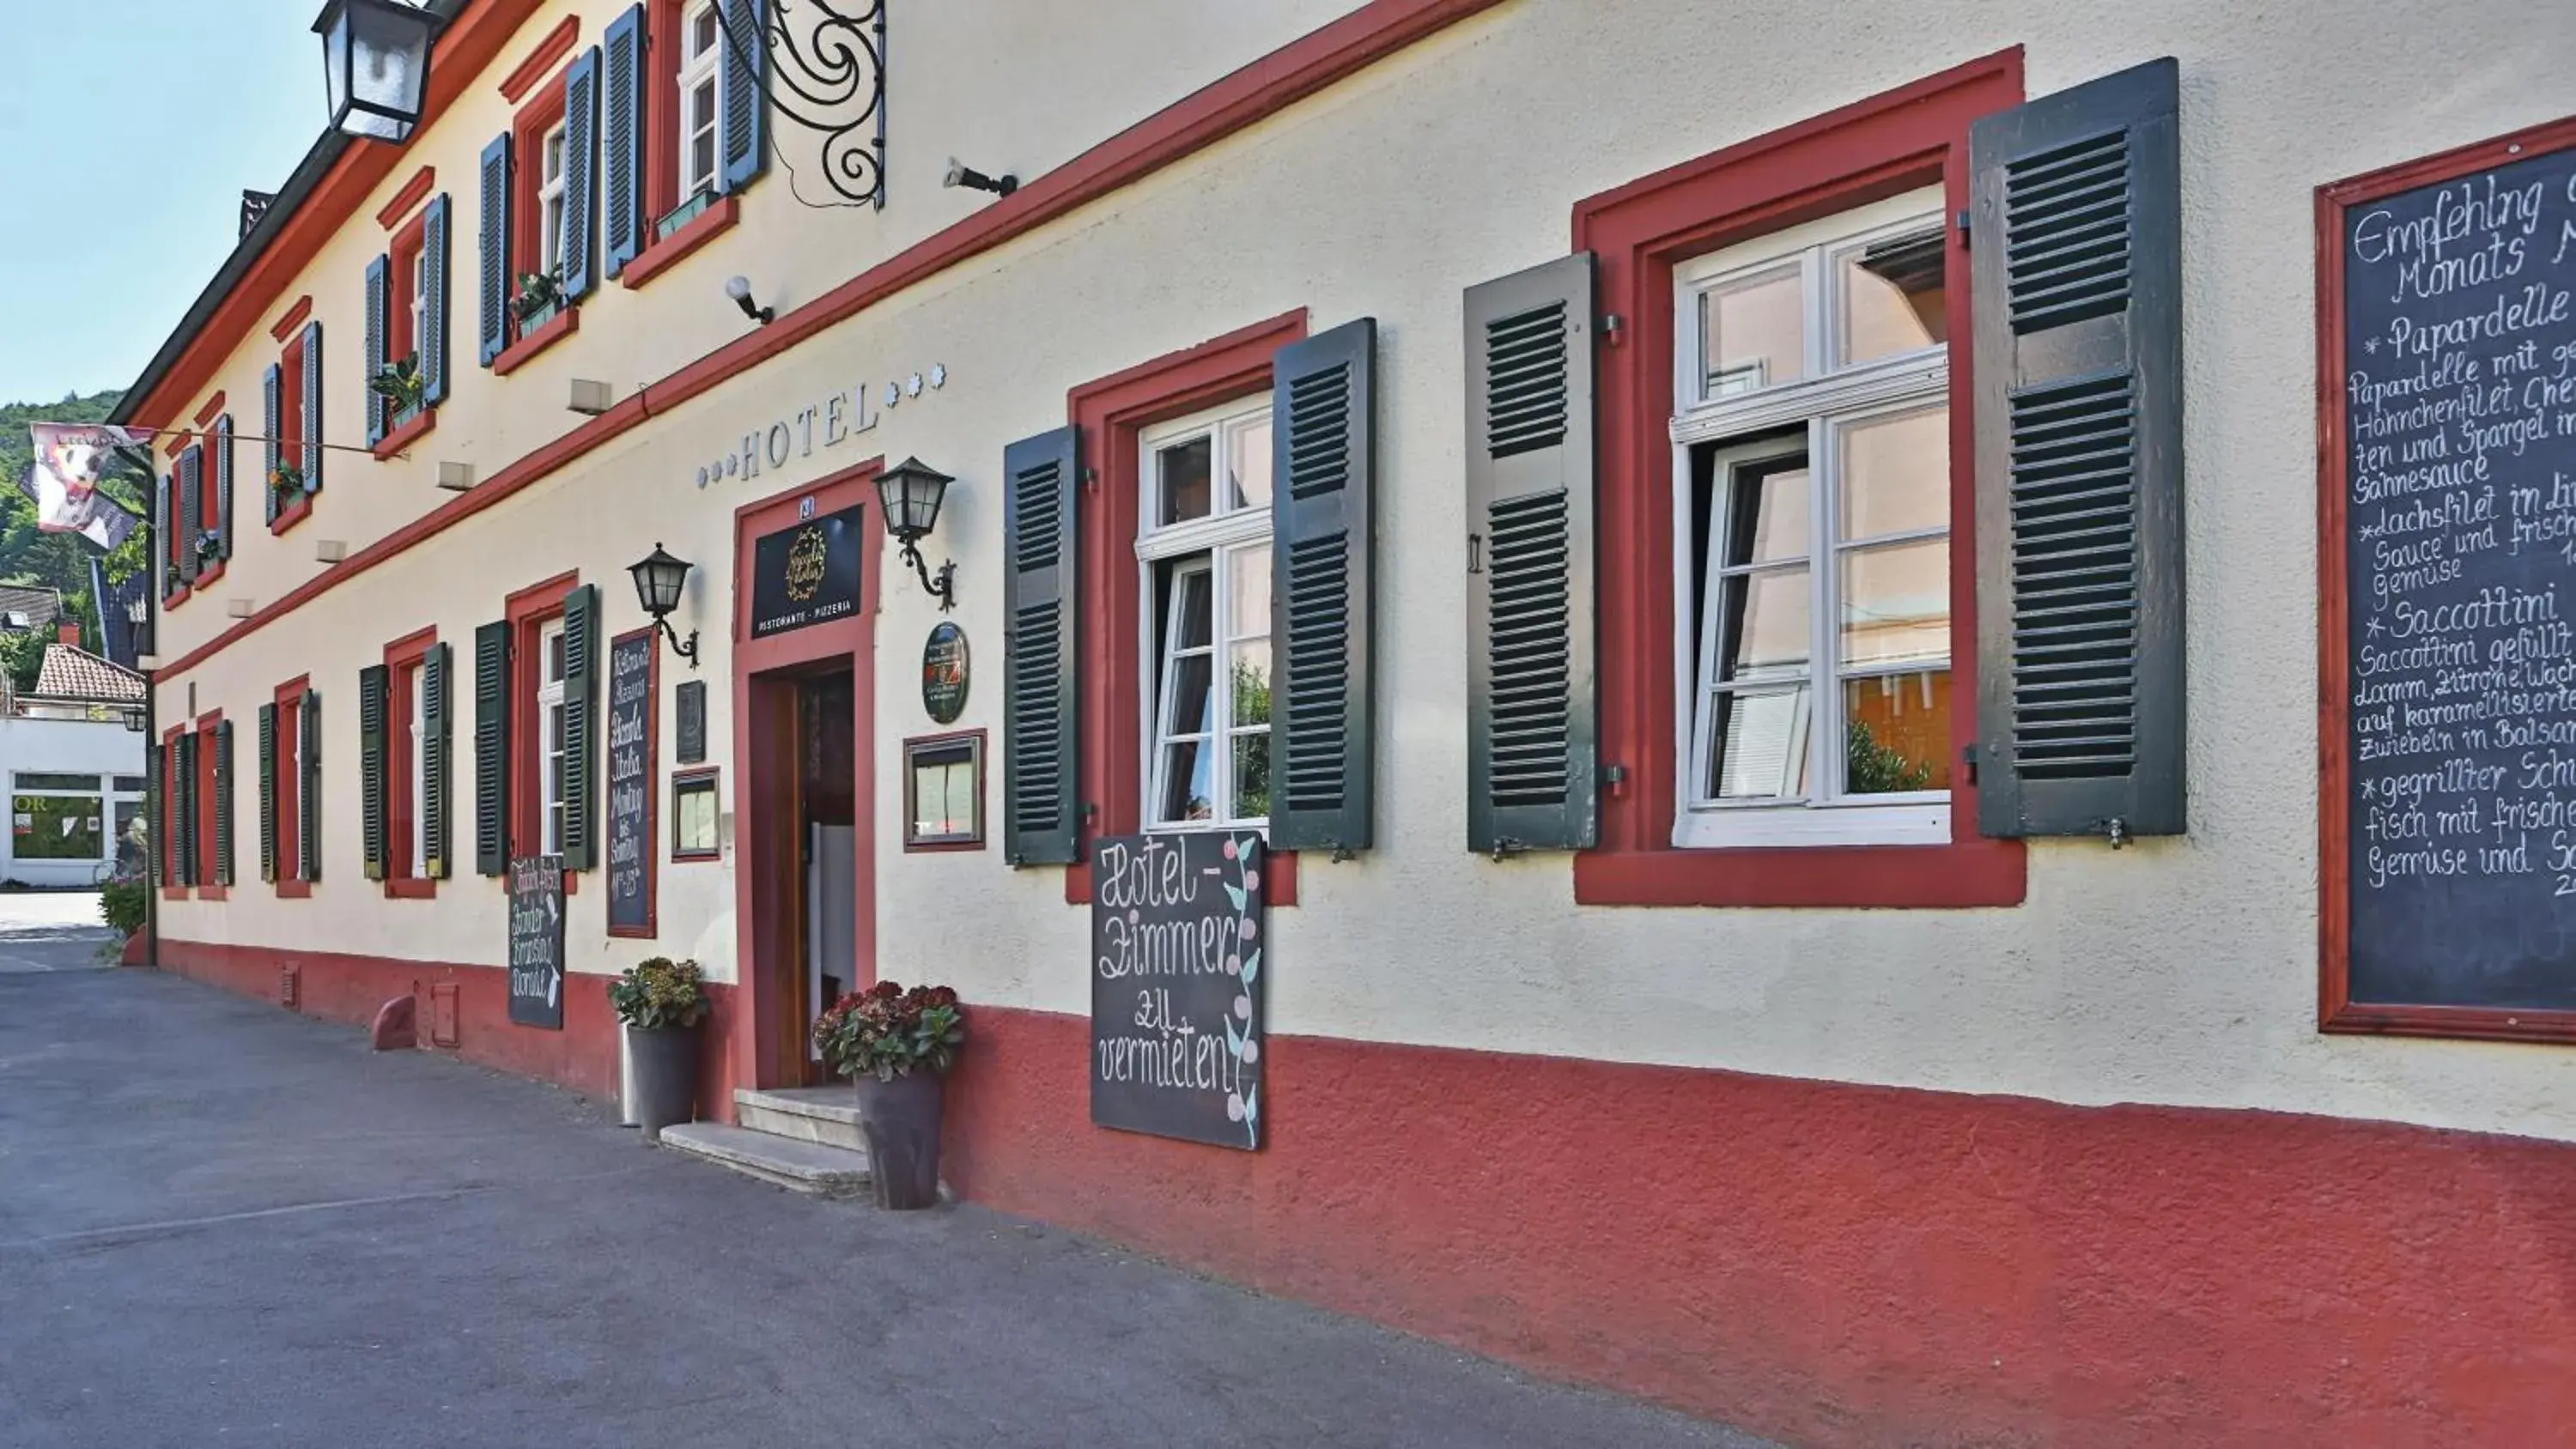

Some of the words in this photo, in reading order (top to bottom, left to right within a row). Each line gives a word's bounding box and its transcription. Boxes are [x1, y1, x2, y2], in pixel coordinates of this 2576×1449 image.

[2391, 232, 2525, 302] Monats
[2387, 282, 2569, 362] Papardelle
[2348, 351, 2479, 413] Papardelle
[2492, 340, 2539, 375] mit
[740, 383, 878, 481] HOTEL
[2355, 444, 2394, 473] ten
[2402, 426, 2451, 463] und
[2458, 408, 2549, 457] Spargel
[2352, 455, 2490, 504] Sahnesauce
[2509, 483, 2541, 516] in
[2372, 537, 2444, 571] Sauce
[2455, 521, 2499, 554] und
[815, 599, 851, 618] PIZZERIA
[2391, 583, 2559, 638] Saccottini
[2355, 634, 2478, 676] Saccottini
[2357, 705, 2395, 739] auf
[2462, 727, 2488, 749] in
[2381, 758, 2506, 808] gegrillter
[2366, 800, 2429, 841] fisch
[2436, 797, 2482, 836] mit
[2479, 831, 2533, 874] und
[1099, 909, 1235, 979] Zimmer
[1099, 1016, 1232, 1092] vermieten
